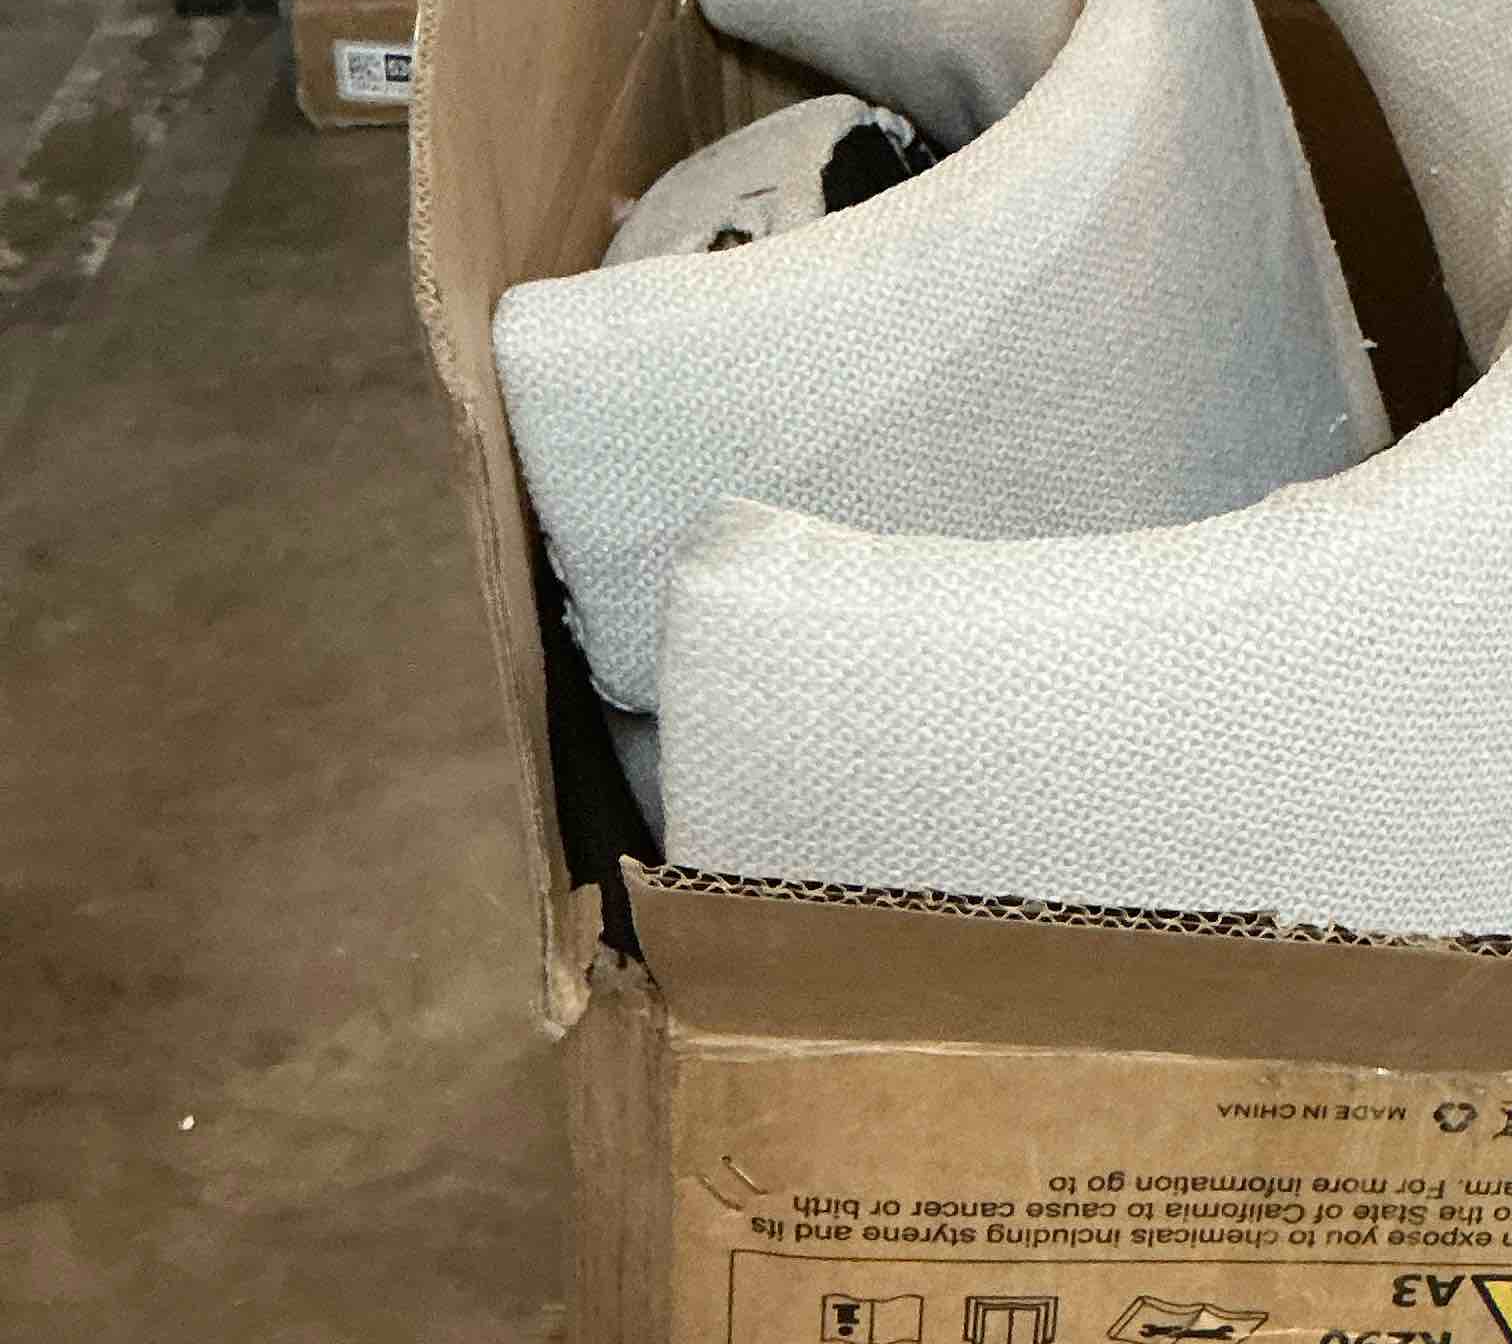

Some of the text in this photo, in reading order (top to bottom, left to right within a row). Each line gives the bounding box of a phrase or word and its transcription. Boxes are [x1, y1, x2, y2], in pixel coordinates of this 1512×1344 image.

[1216, 1102, 1407, 1121] MADE IN CHINA
[1048, 1175, 1077, 1195] to
[1087, 1170, 1126, 1194] go
[1136, 1175, 1302, 1198] information
[1311, 1177, 1388, 1196] more
[1392, 1178, 1447, 1200] For
[793, 1196, 861, 1220] birth
[871, 1199, 901, 1217] or
[910, 1200, 1016, 1219] cancer
[1026, 1201, 1117, 1219] cause
[1127, 1201, 1154, 1222] to
[1165, 1201, 1305, 1226] California
[1312, 1203, 1343, 1225] of
[1353, 1204, 1429, 1226] State
[1439, 1205, 1484, 1226] the
[750, 1216, 784, 1243] its
[794, 1222, 853, 1243] and
[862, 1221, 977, 1246] styrene
[986, 1222, 1121, 1249] including
[1129, 1226, 1280, 1249] chemicals
[1289, 1229, 1316, 1248] to
[1327, 1226, 1378, 1247] you
[1387, 1227, 1493, 1247] expose
[1391, 1273, 1467, 1308] A3
